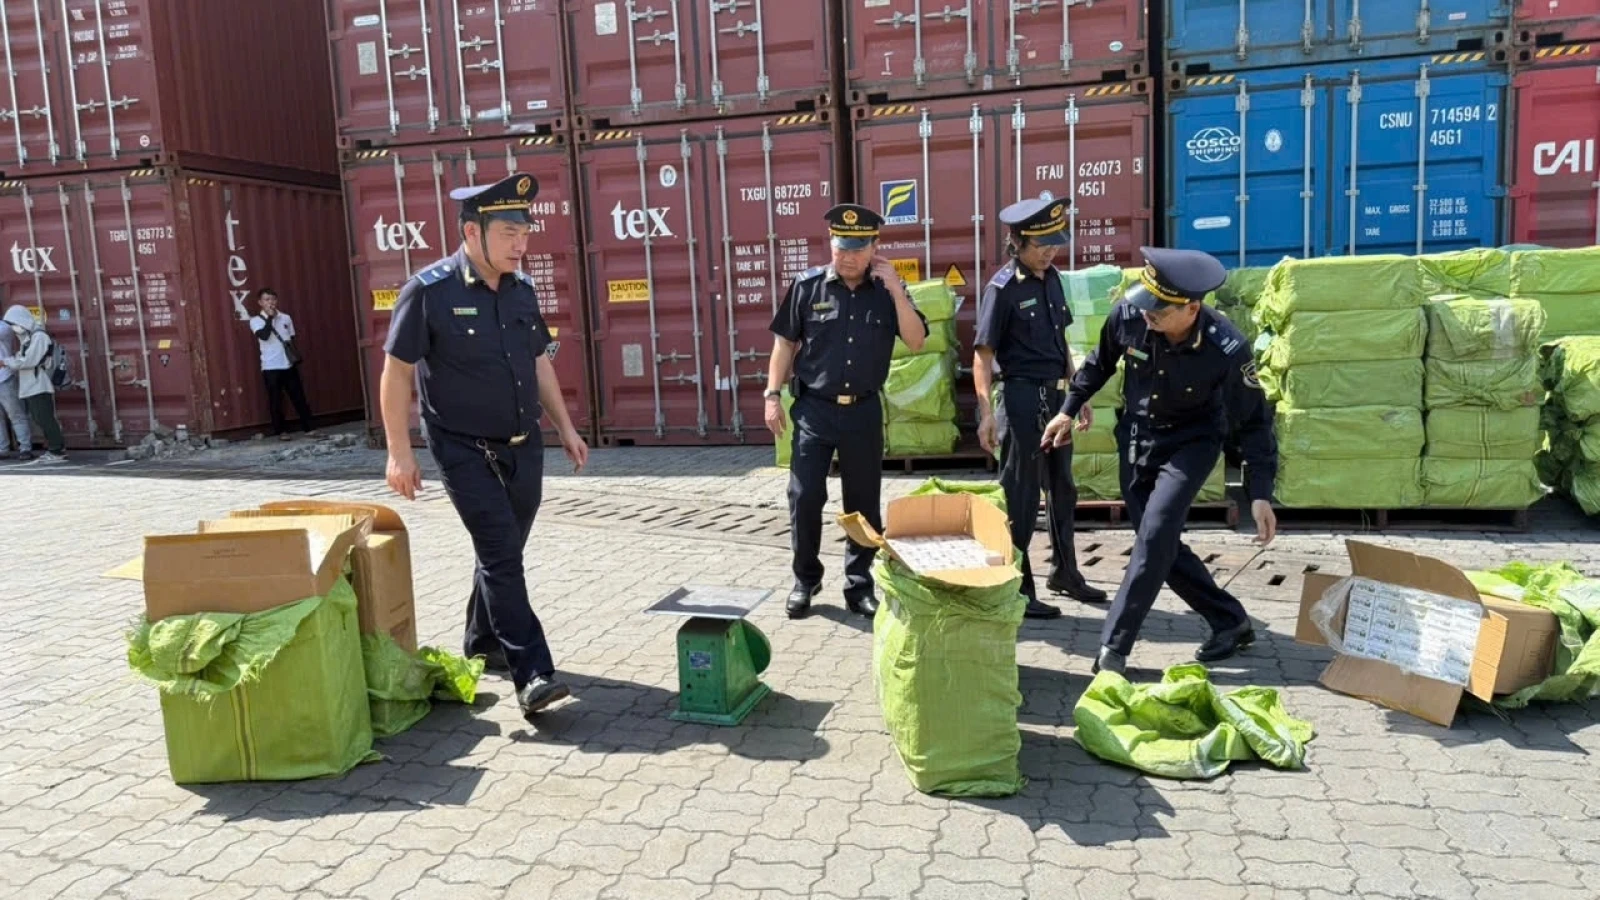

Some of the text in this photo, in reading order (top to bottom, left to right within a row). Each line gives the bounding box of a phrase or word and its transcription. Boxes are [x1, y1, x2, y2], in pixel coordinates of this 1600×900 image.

[1379, 104, 1497, 129] CSNU 714594 2
[1186, 135, 1240, 149] COSCO
[1429, 129, 1461, 145] 45G1
[1188, 146, 1239, 156] SHIPPING
[1533, 139, 1595, 175] CAI
[1035, 157, 1143, 180] FFAU 626073 3
[740, 181, 830, 201] TXGU 687226 7
[1078, 181, 1106, 196] 45G1
[775, 202, 800, 216] 45G1
[610, 282, 648, 292] CAUTION
